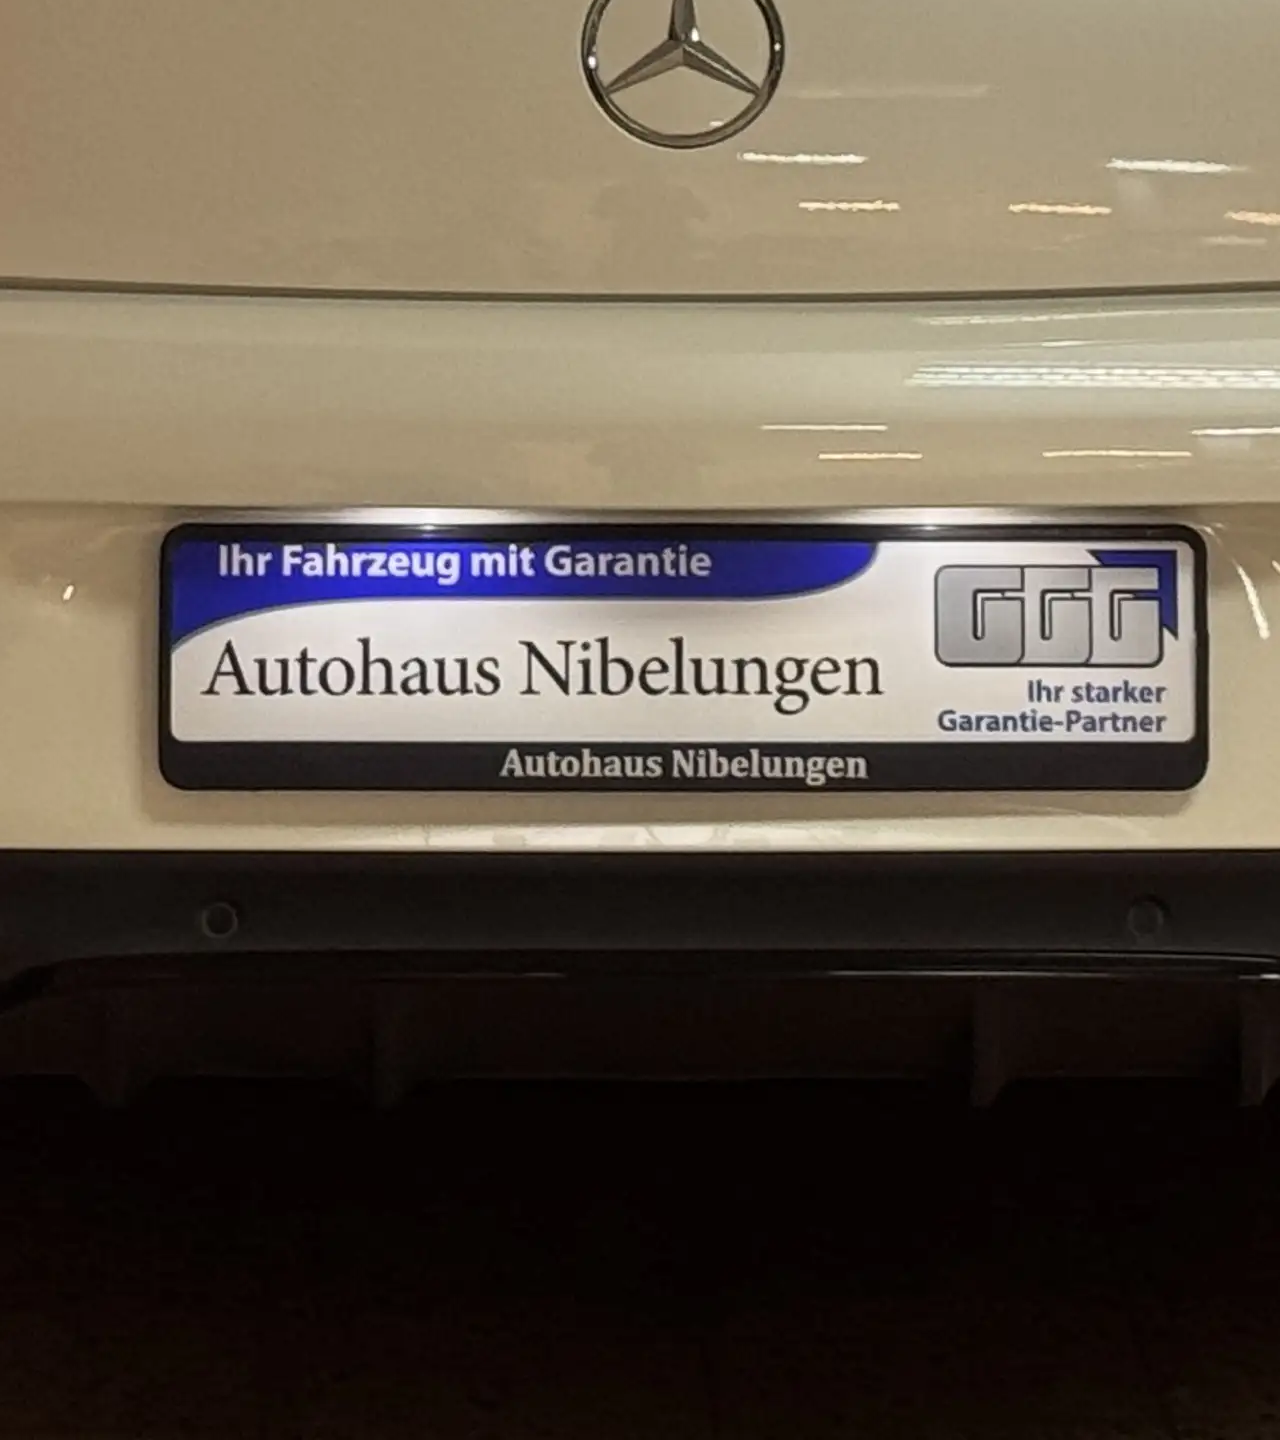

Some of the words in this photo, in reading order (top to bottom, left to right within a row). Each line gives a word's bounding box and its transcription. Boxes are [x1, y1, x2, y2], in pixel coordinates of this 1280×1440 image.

[219, 544, 272, 577] Ihr
[282, 543, 461, 586] Fahrzeug
[471, 544, 535, 577] mit
[544, 545, 712, 577] Garantie
[201, 638, 500, 697] Autohaus
[519, 637, 883, 716] Nibelungen
[1028, 680, 1063, 704] Ihr
[1071, 679, 1168, 704] starker
[937, 709, 1168, 734] Garantie-Partner
[500, 748, 663, 778] Autohaus
[672, 748, 869, 786] Nibelungen
